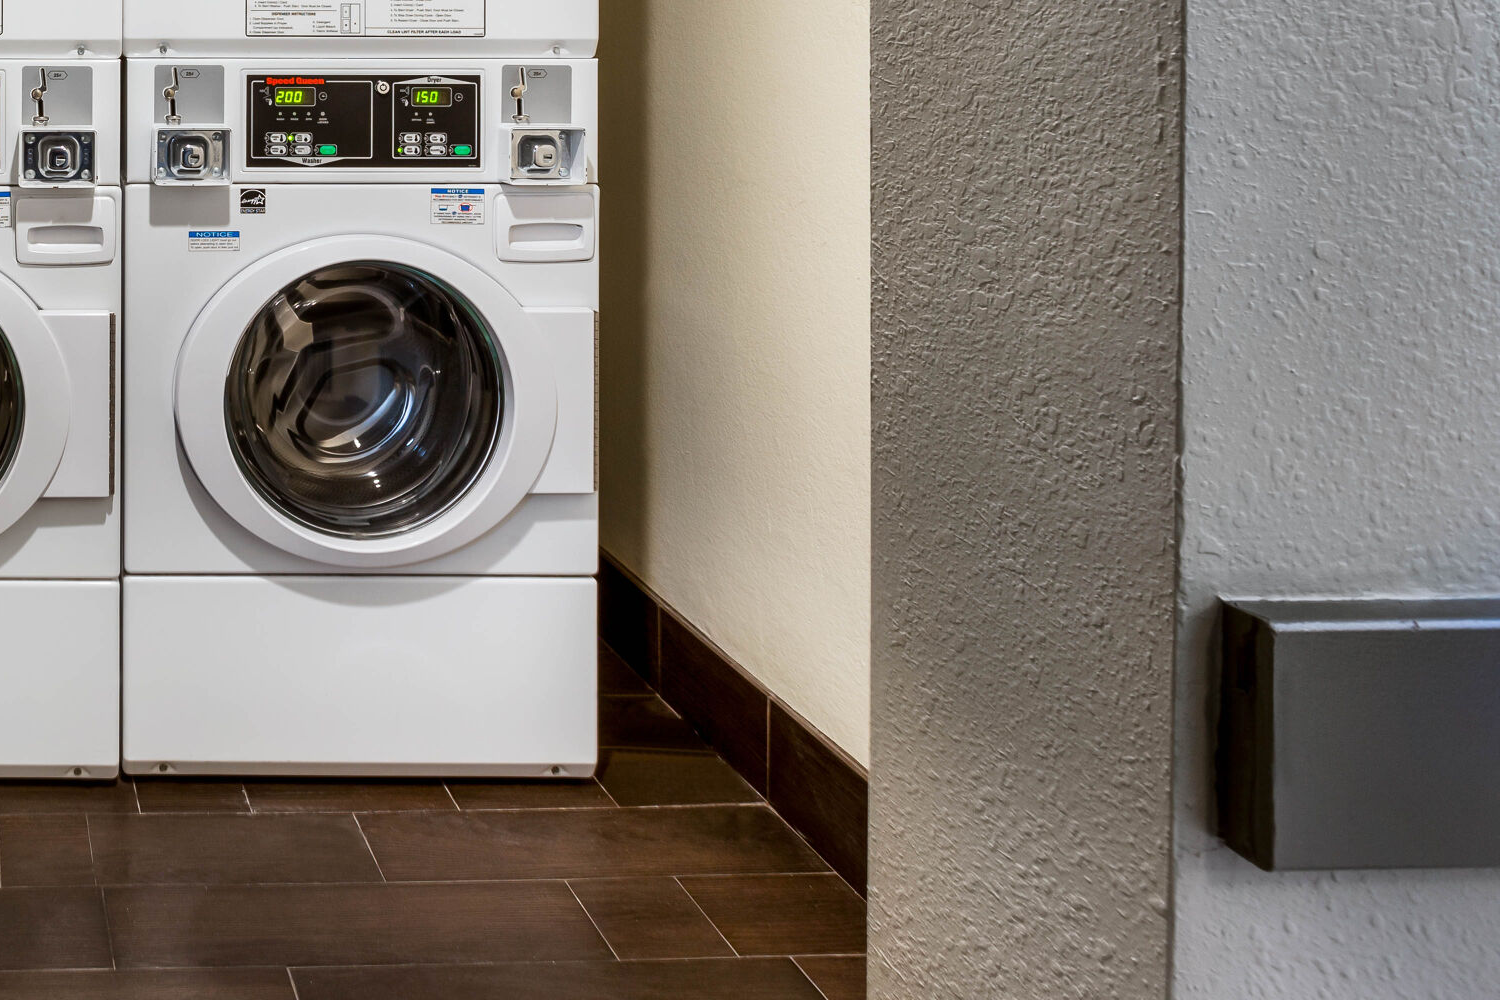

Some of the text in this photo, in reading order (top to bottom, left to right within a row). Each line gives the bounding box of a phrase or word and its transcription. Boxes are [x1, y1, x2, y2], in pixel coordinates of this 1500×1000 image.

[266, 77, 294, 86] Speed
[276, 91, 303, 103] 200
[416, 91, 438, 103] 150
